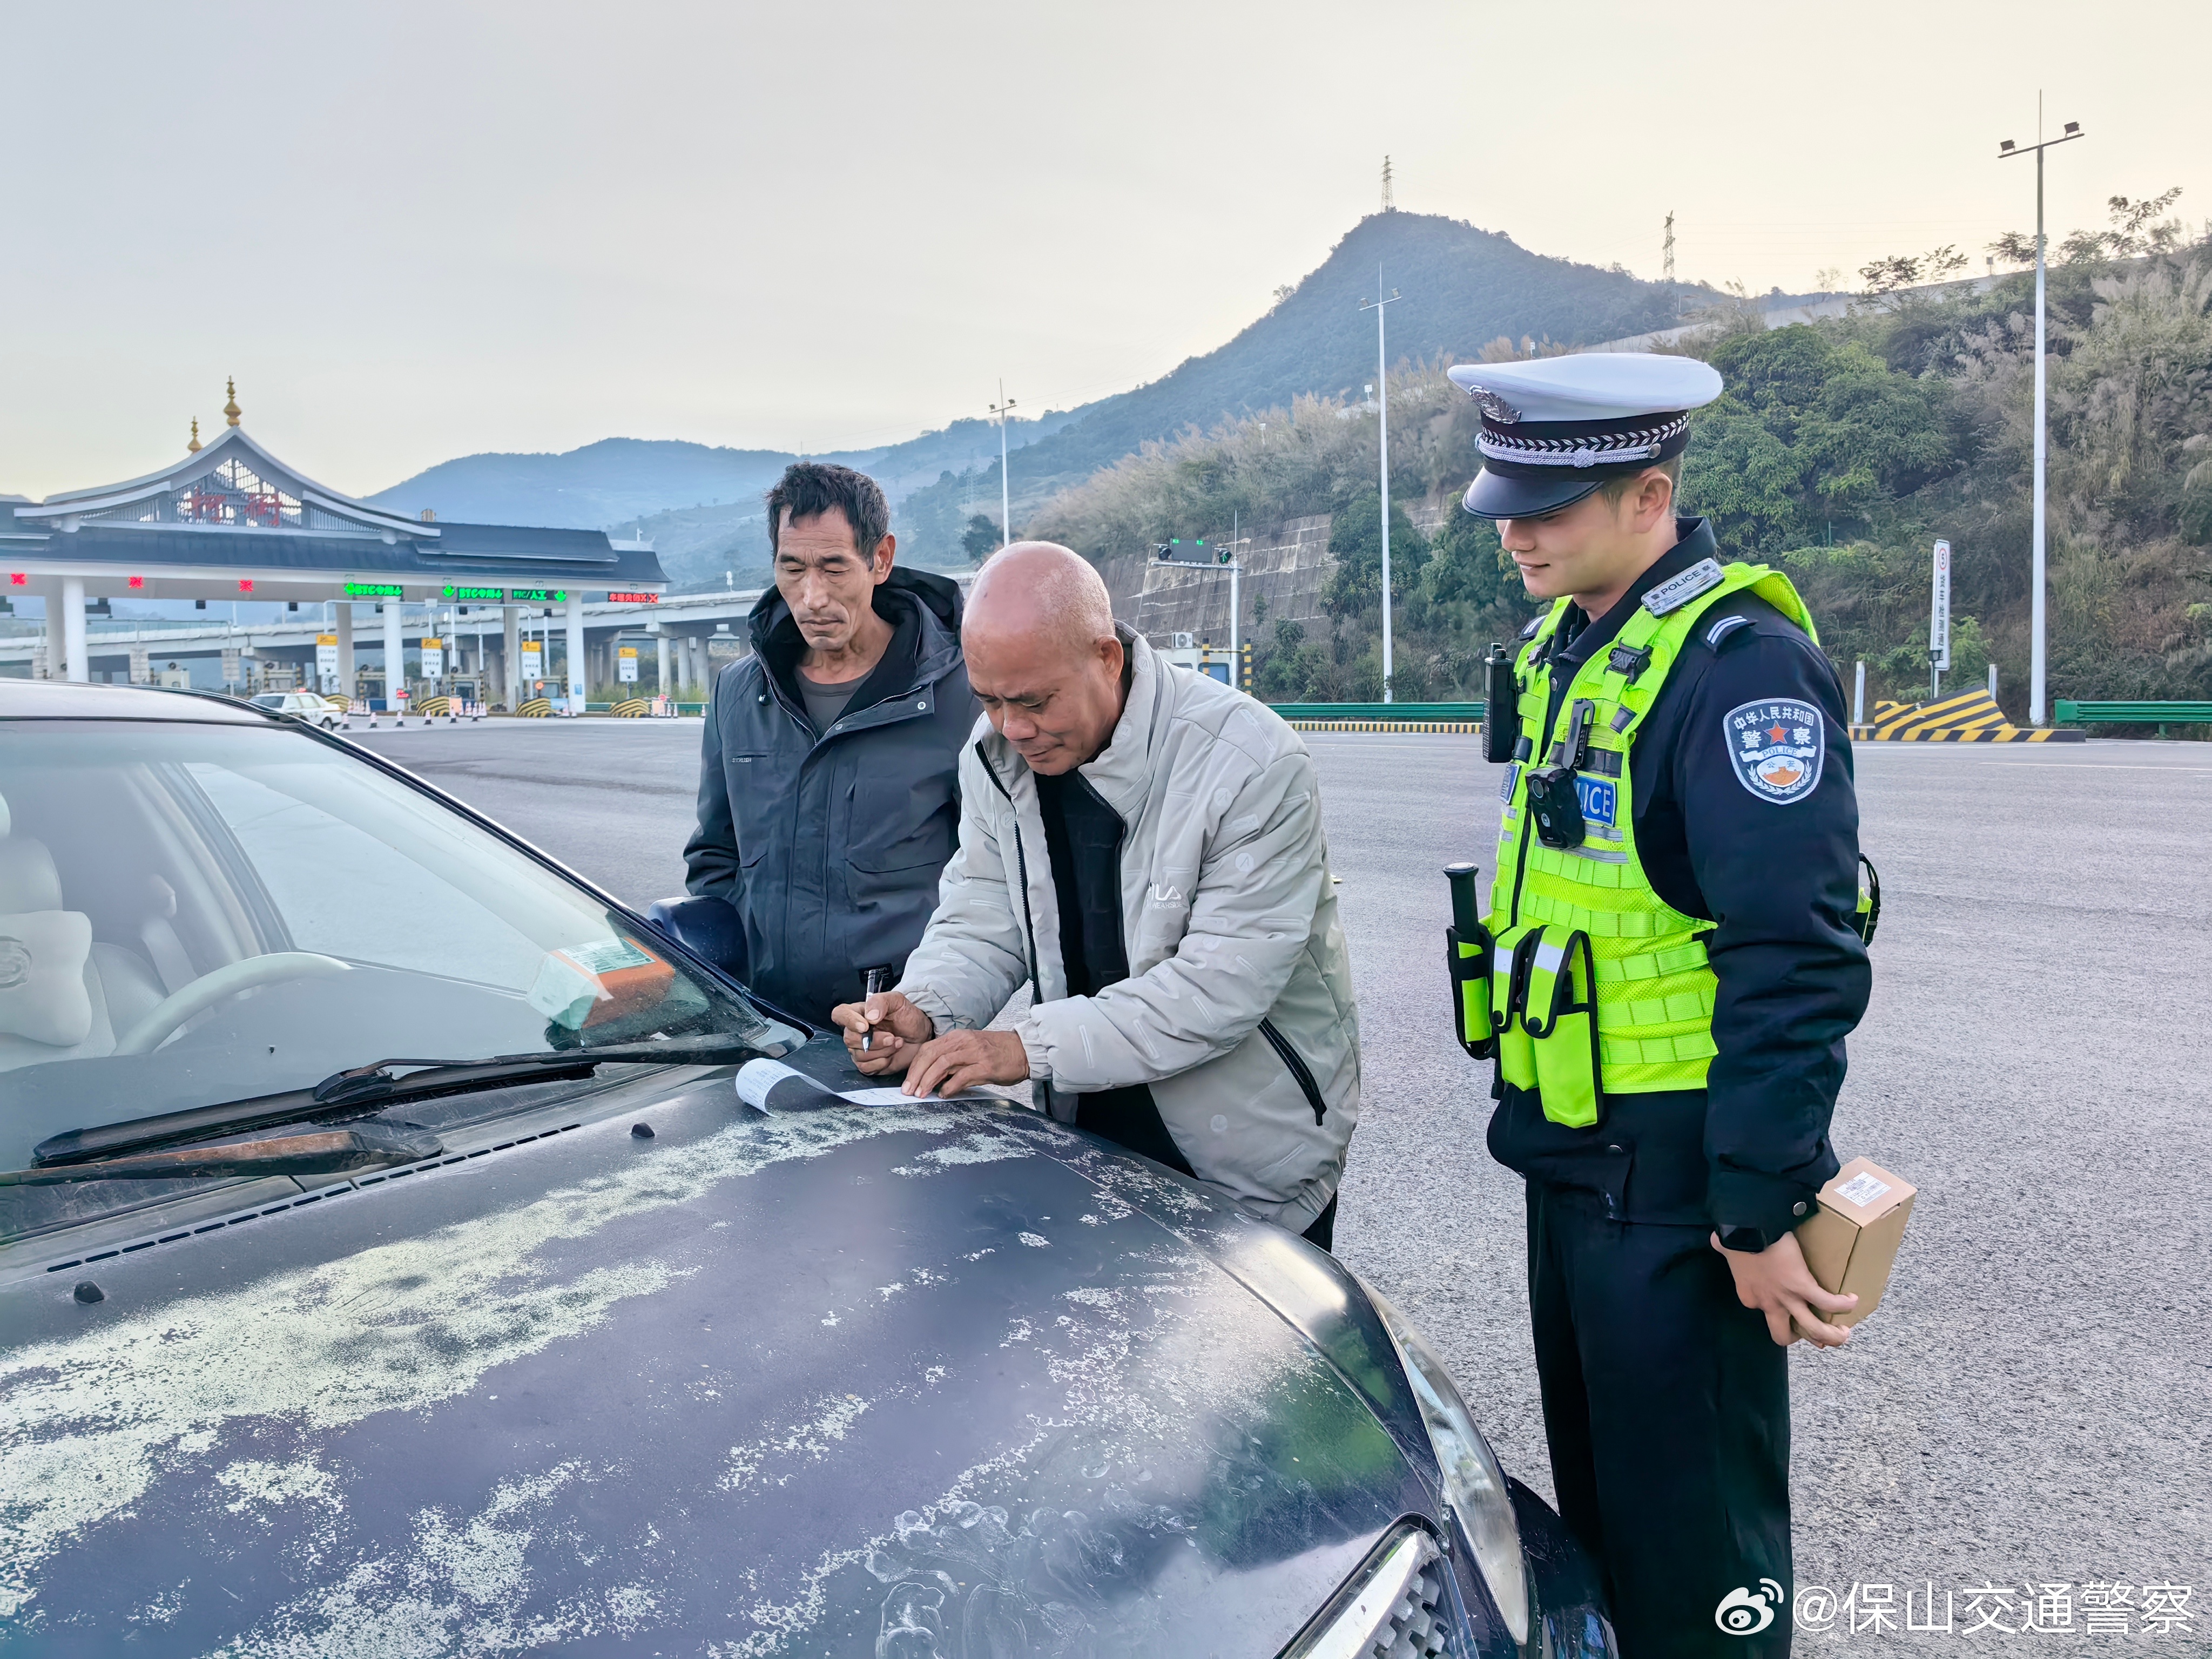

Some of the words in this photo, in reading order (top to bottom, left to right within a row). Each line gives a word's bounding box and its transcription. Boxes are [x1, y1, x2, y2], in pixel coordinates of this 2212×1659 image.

[1661, 570, 1702, 595] POLICE
[1734, 706, 1815, 730] 中华人民共和国
[1742, 730, 1762, 749] 警
[1792, 726, 1811, 745] 察
[1762, 747, 1798, 758] POLICE
[1786, 760, 1796, 768] 安
